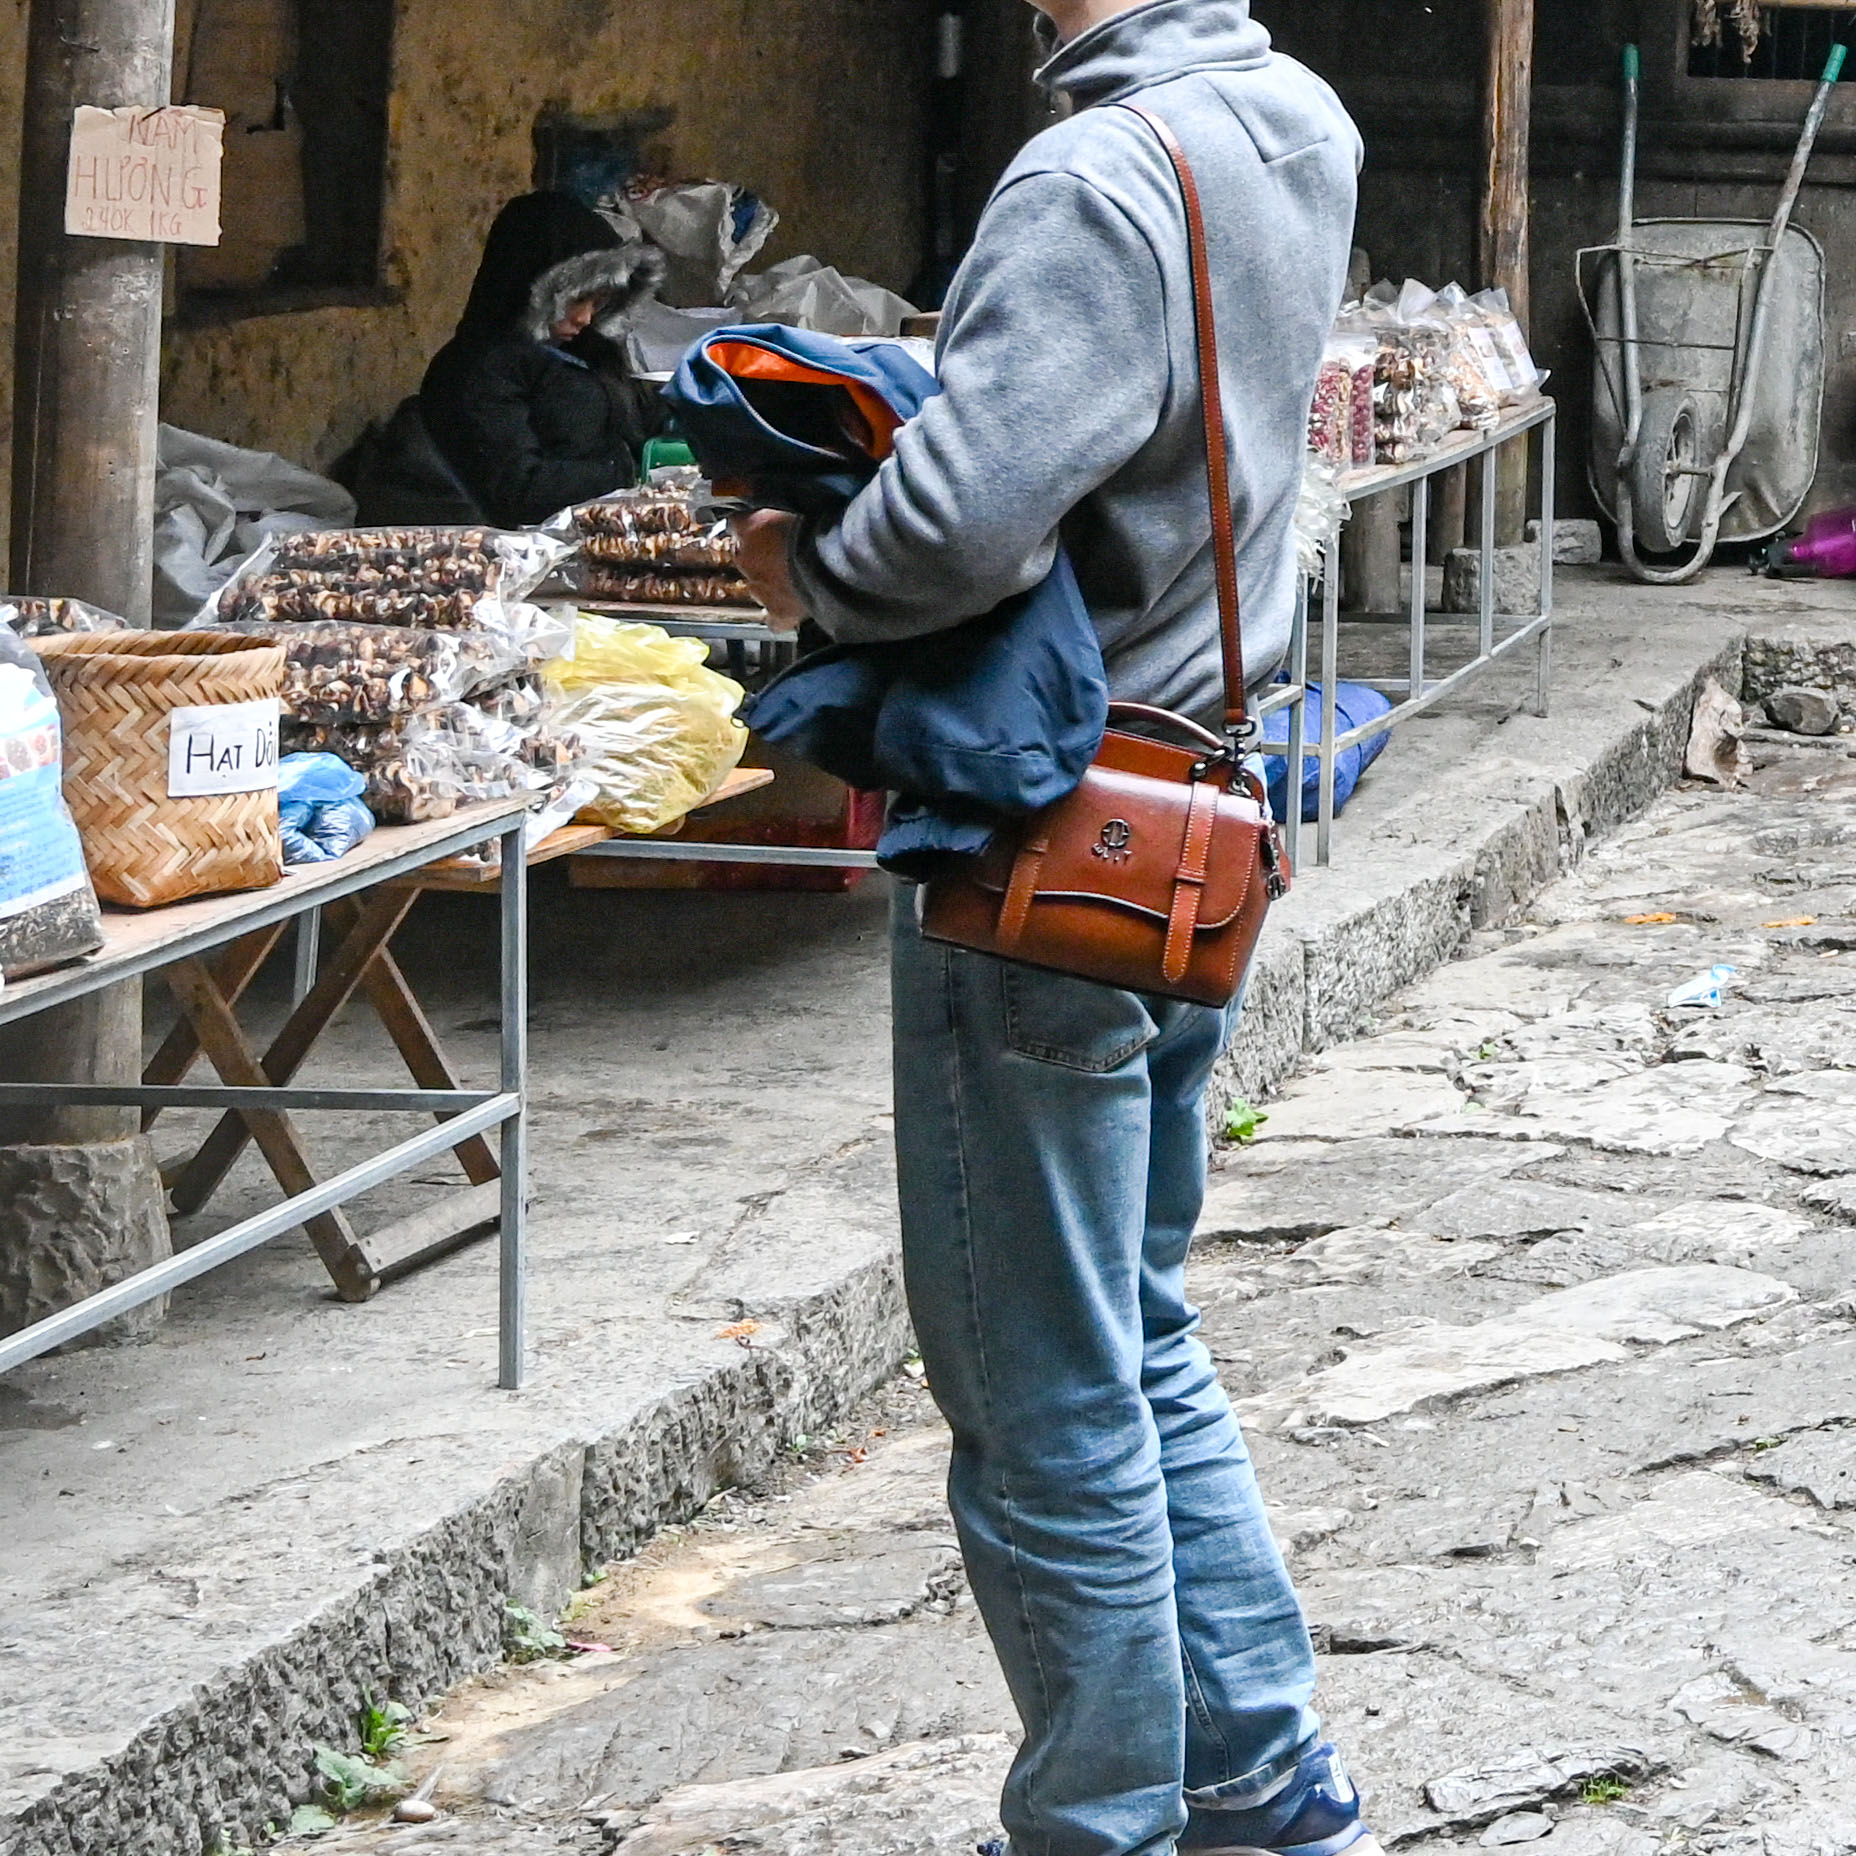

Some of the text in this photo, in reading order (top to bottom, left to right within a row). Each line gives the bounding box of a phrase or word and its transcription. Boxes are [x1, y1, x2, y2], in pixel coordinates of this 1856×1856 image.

[75, 155, 208, 209] HƯƠNG
[82, 207, 182, 236] 240K 1KG
